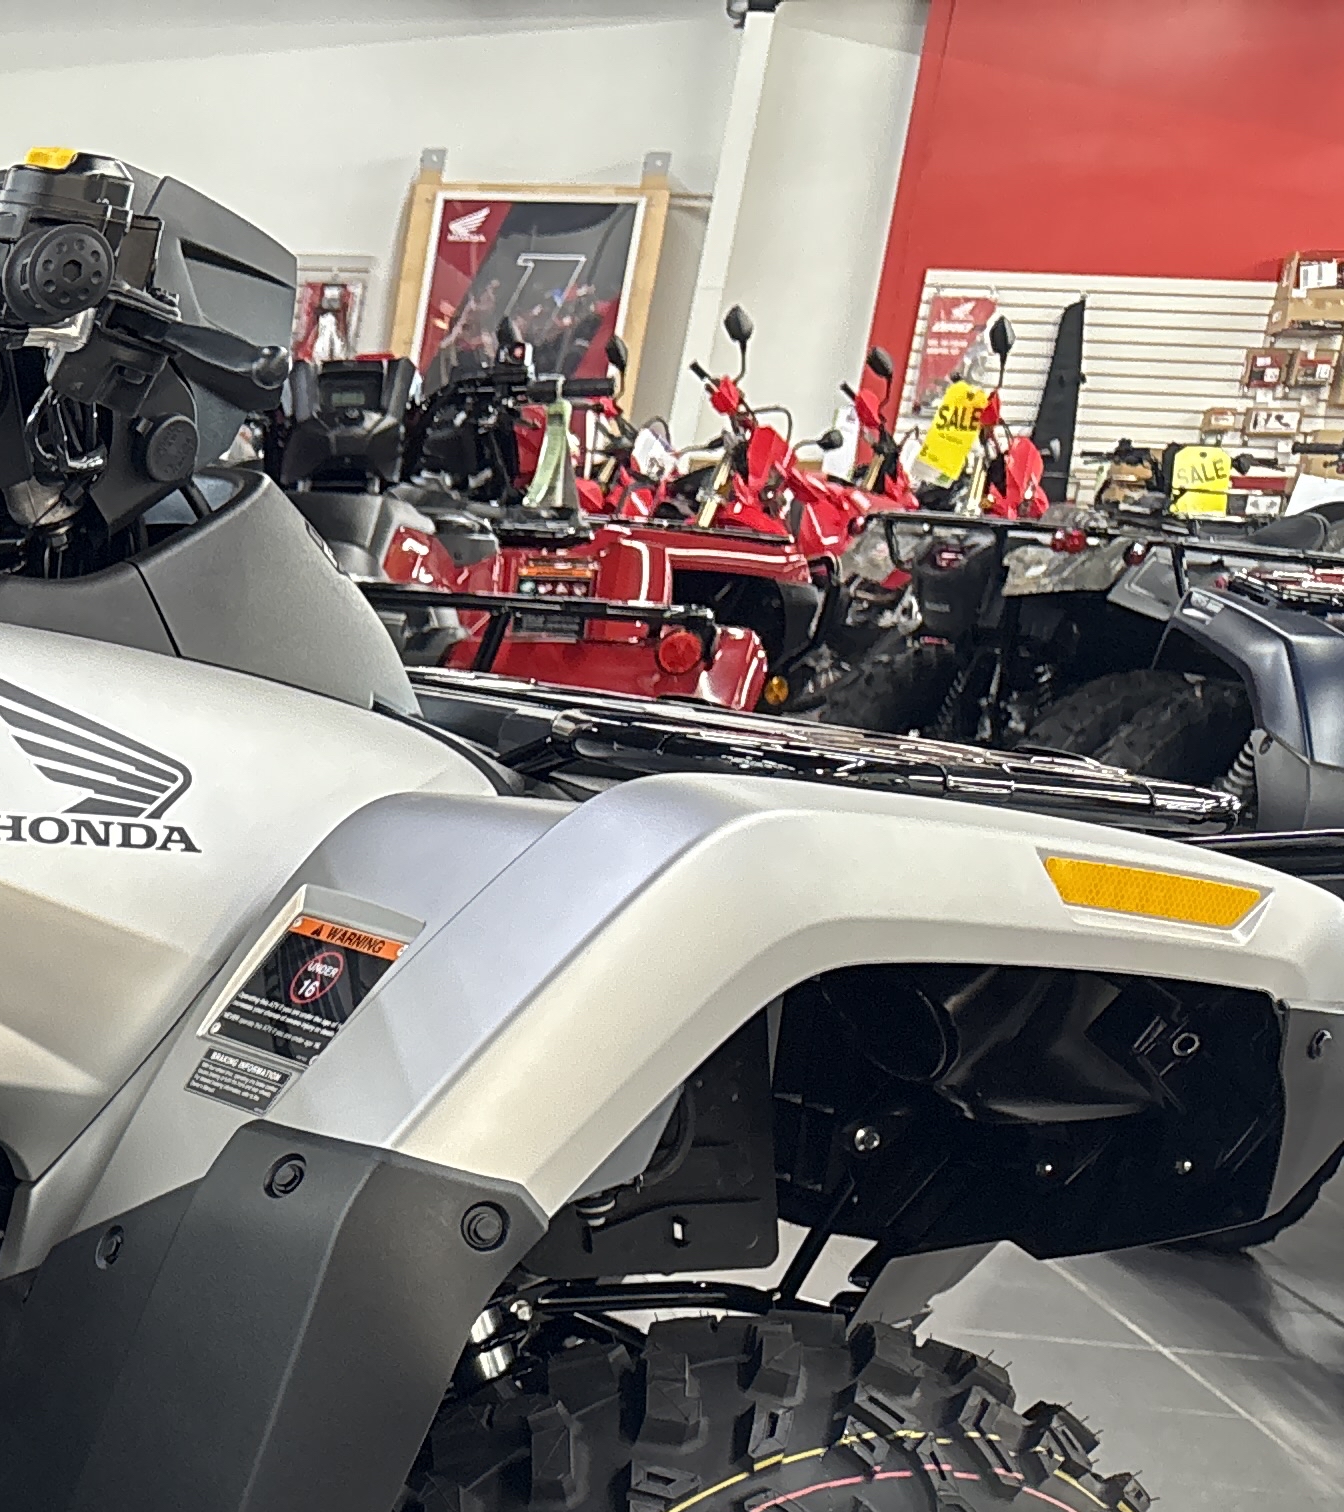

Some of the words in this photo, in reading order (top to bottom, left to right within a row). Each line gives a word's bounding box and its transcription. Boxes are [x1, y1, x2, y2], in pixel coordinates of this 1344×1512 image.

[935, 404, 984, 432] SALE
[1176, 457, 1228, 485] SALE
[325, 926, 387, 954] WARNING
[307, 960, 340, 979] UNDER
[297, 978, 320, 998] 16
[210, 1051, 240, 1070] BRAKING
[237, 1059, 283, 1083] INFORMATION
